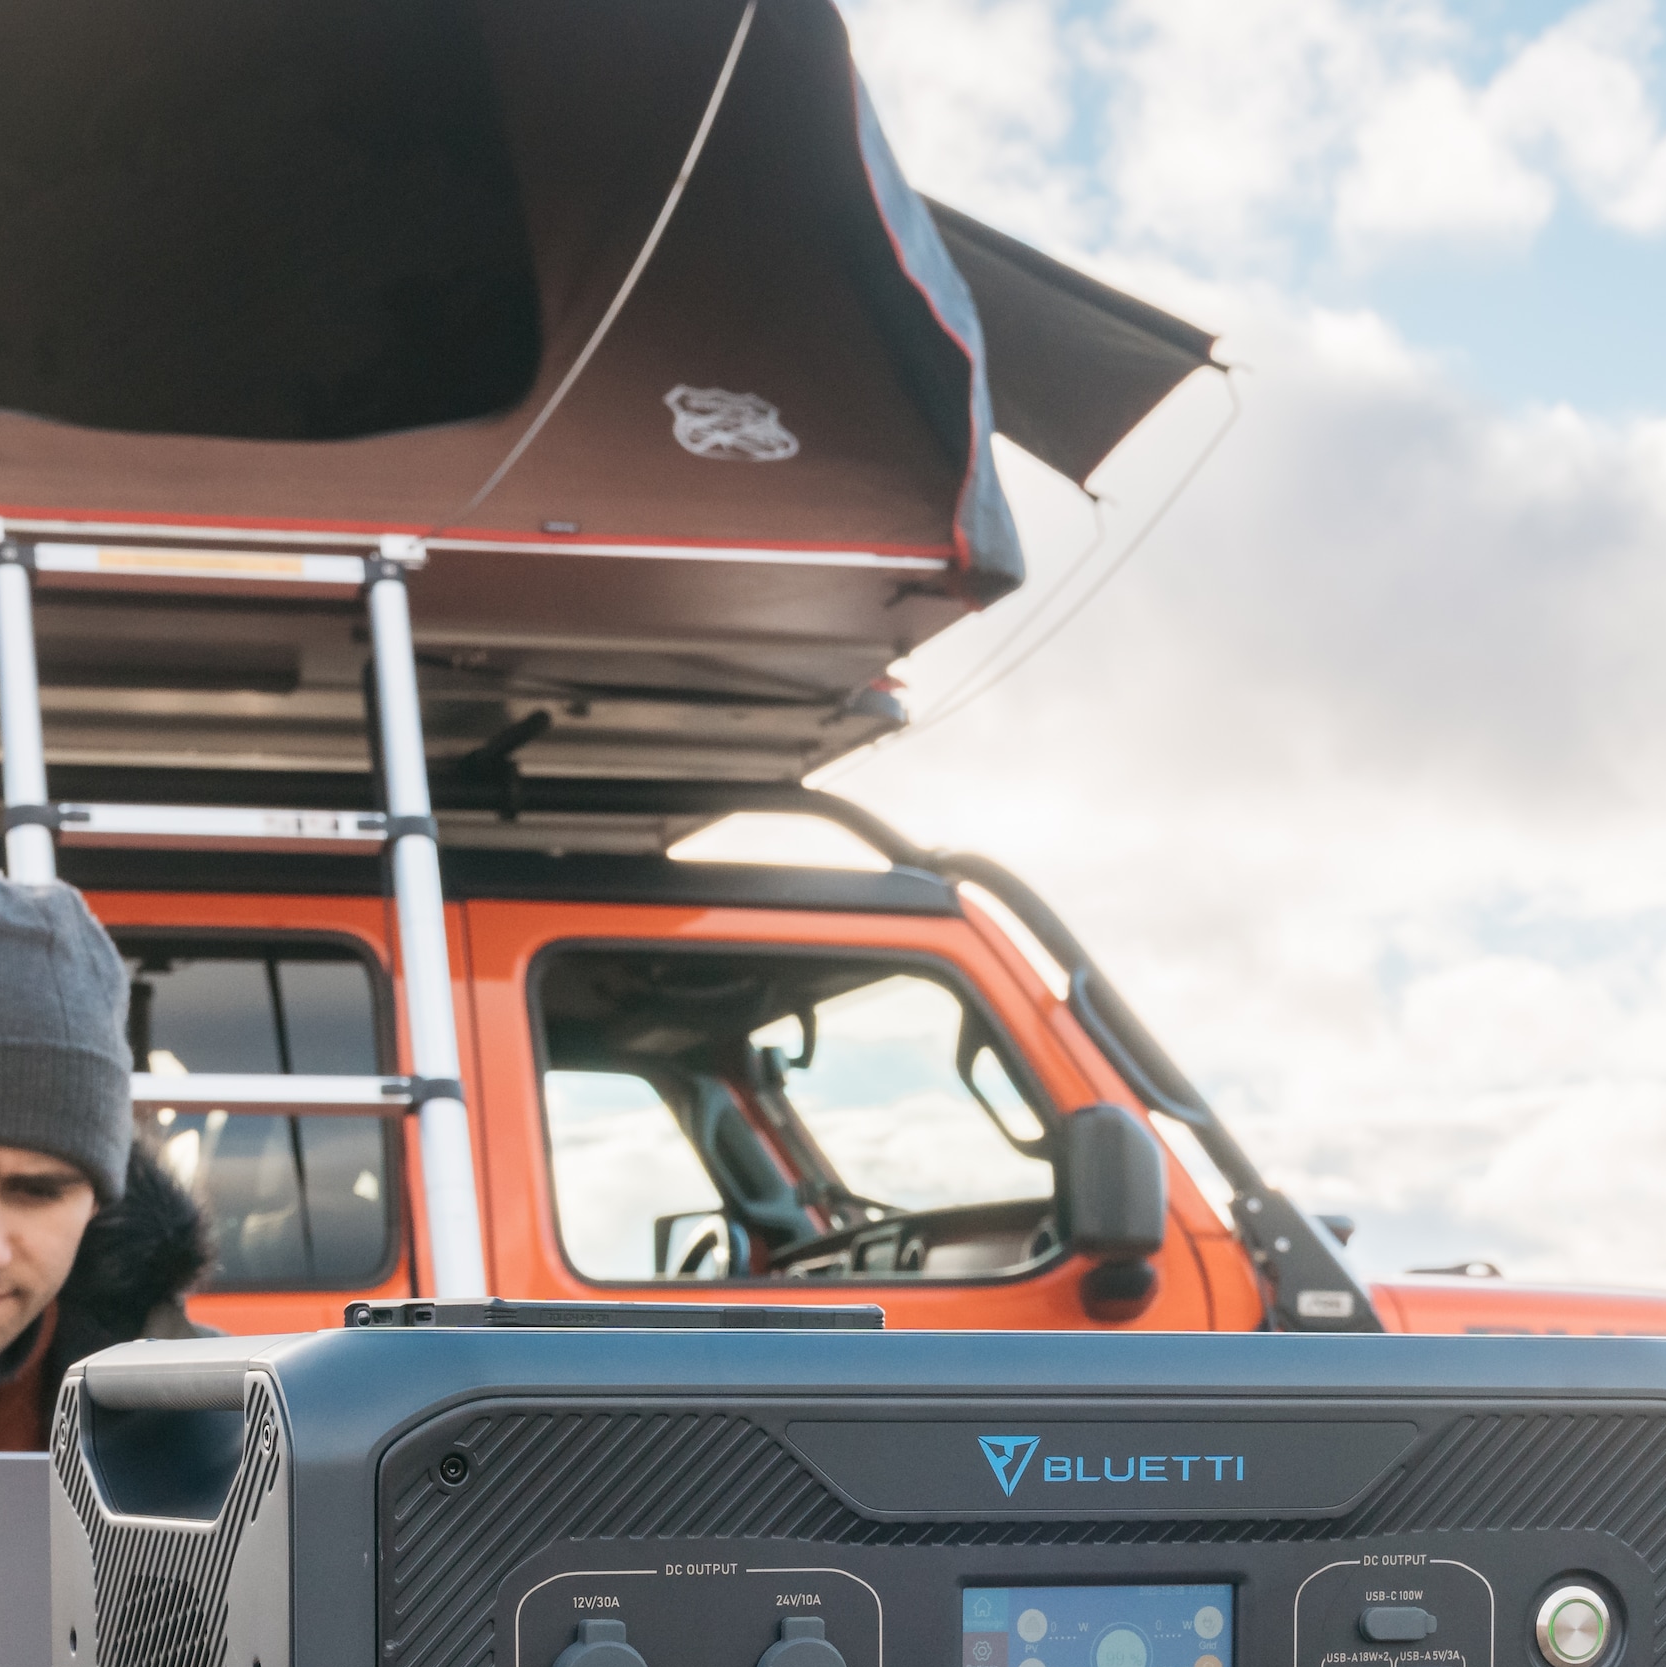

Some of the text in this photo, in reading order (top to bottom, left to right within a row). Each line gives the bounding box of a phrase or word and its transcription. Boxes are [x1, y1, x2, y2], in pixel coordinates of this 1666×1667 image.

[1043, 1455, 1244, 1482] BLUETTI
[1363, 1554, 1427, 1566] DC OUTPUT
[665, 1563, 738, 1576] DC OUTPUT
[776, 1594, 821, 1606] 24V/10A
[1365, 1590, 1424, 1601] USB-C 100W
[573, 1596, 620, 1609] 12V/30A
[1078, 1622, 1090, 1633] W
[1182, 1620, 1193, 1631] W
[1199, 1641, 1217, 1651] Grid
[1326, 1653, 1358, 1663] USB-A
[1400, 1650, 1460, 1662] USB-A 5V/3A
